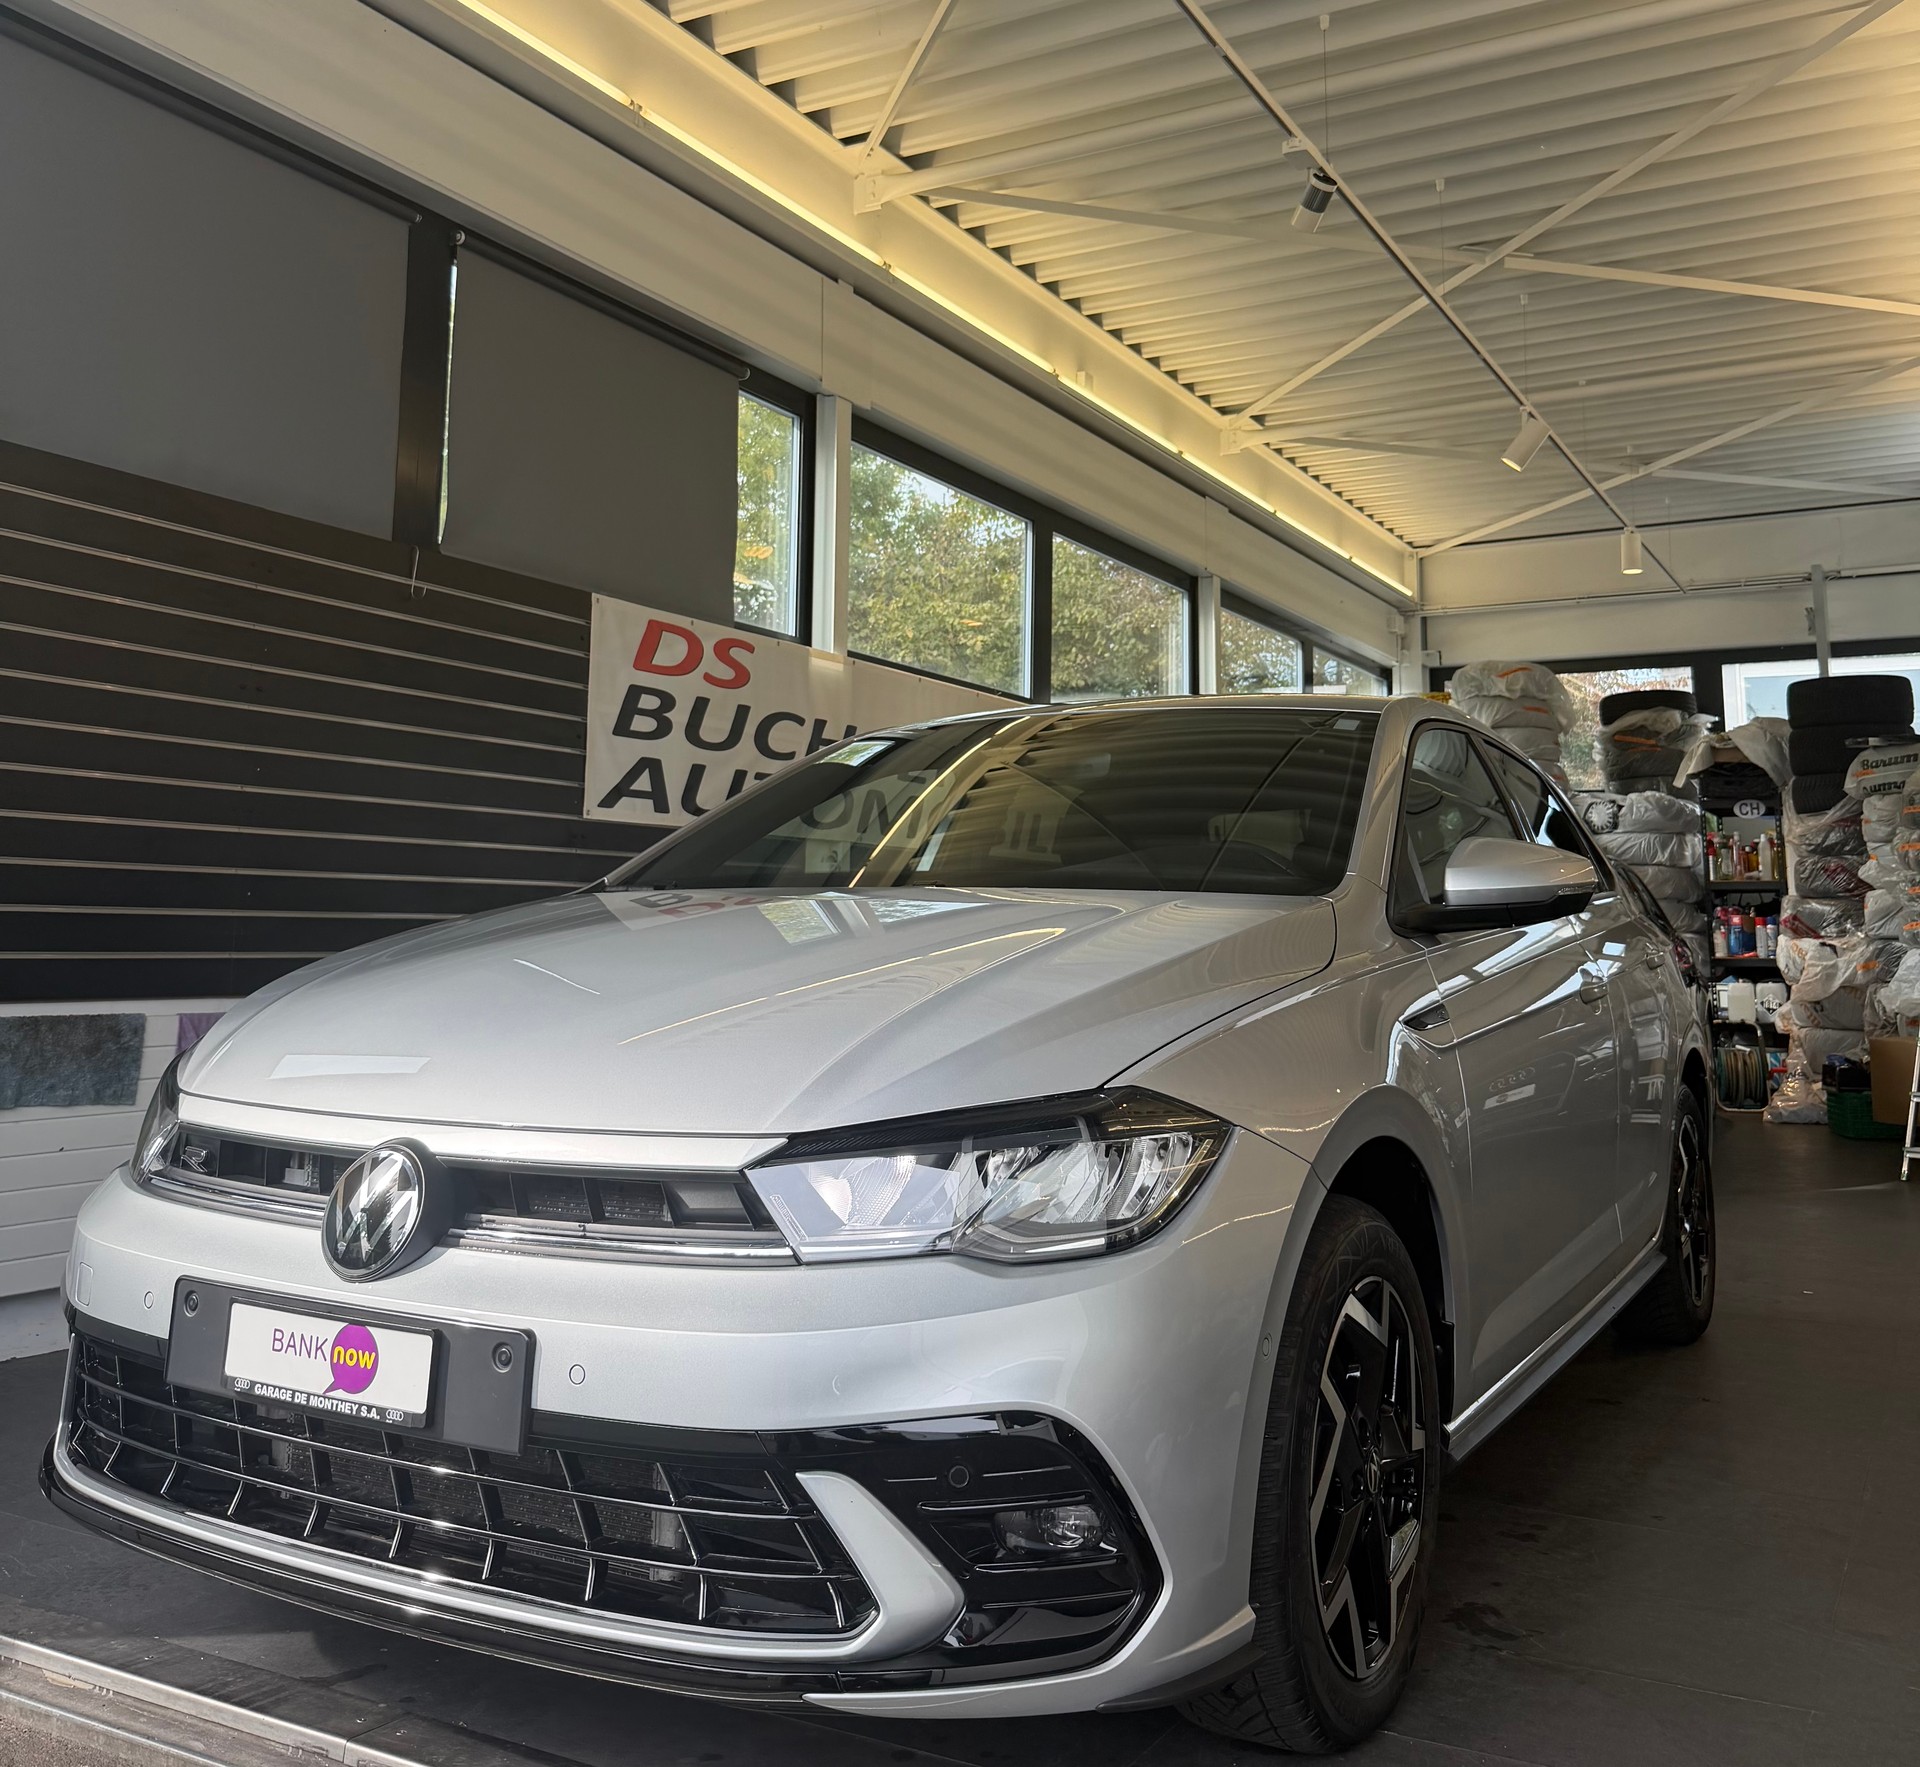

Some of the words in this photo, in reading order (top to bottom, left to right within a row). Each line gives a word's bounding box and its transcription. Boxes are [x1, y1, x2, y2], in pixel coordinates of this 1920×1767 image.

[633, 619, 755, 689] DS
[1739, 802, 1760, 816] CH
[272, 1328, 328, 1362] BANK
[333, 1345, 376, 1370] now
[254, 1383, 293, 1401] GARAGE
[296, 1393, 308, 1405] DE
[309, 1395, 359, 1415] MONTHEY
[360, 1405, 381, 1420] S.A.
